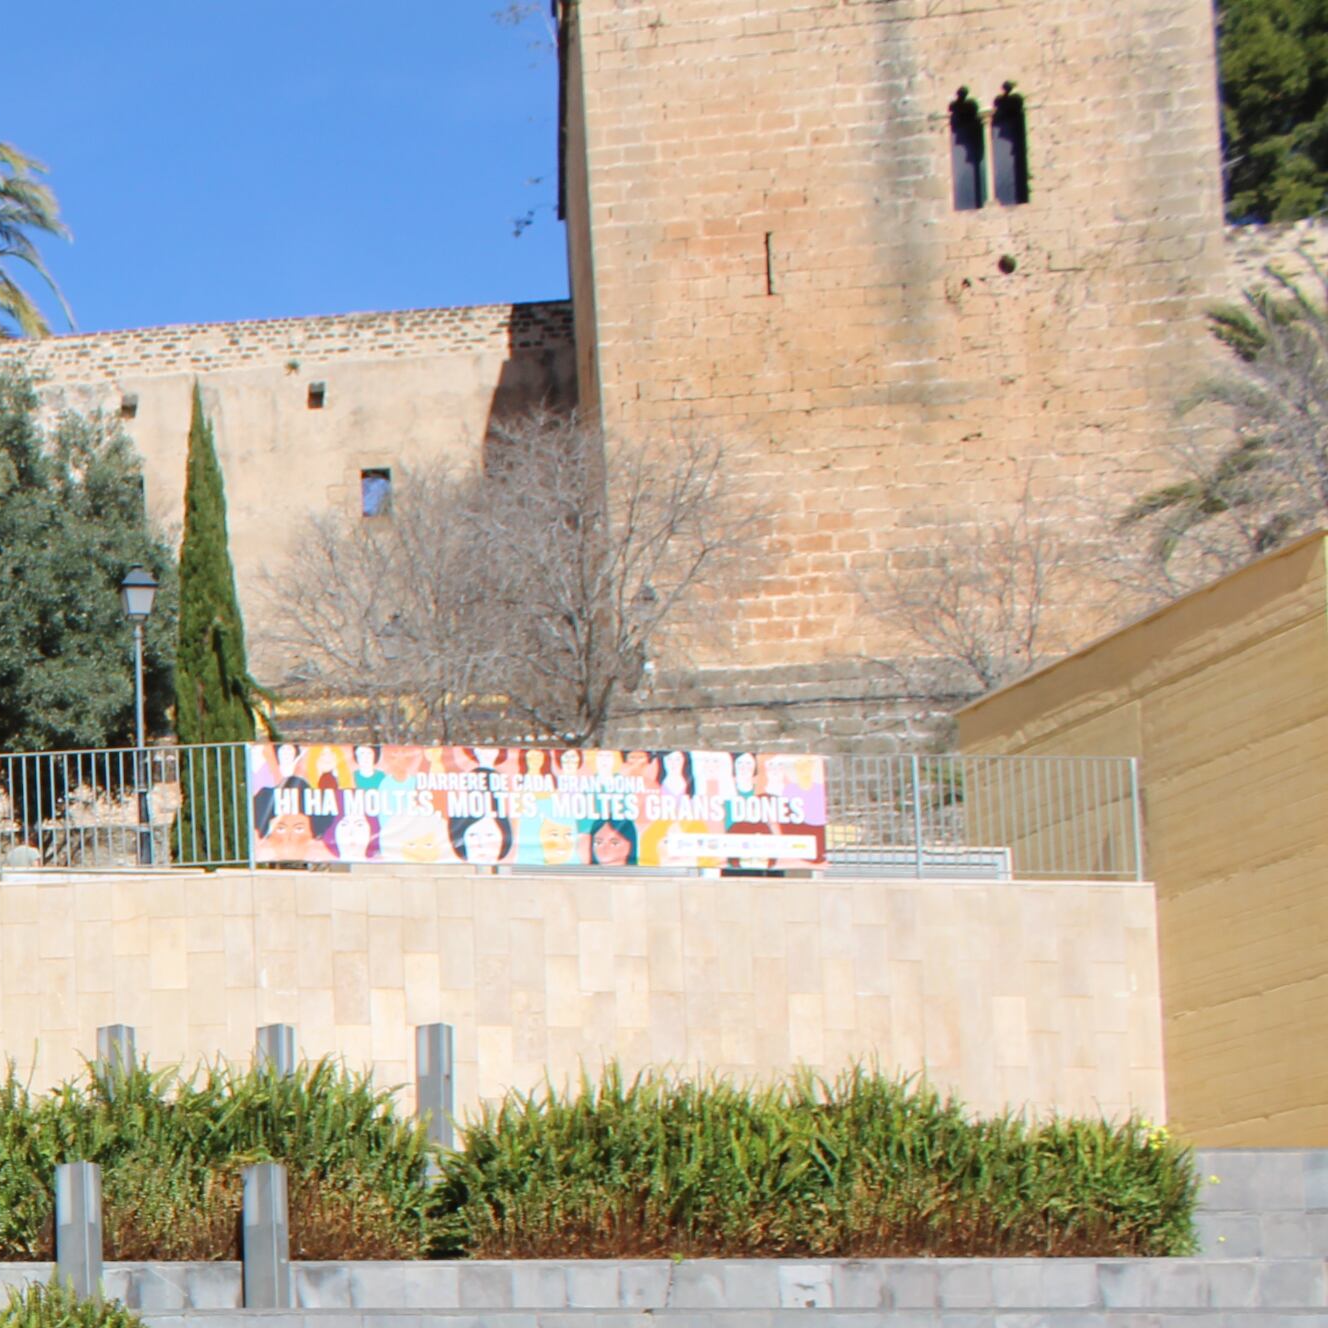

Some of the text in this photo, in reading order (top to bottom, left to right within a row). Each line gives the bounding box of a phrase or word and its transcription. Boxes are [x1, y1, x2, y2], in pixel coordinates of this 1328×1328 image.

[416, 772, 487, 791] DARRERE
[491, 773, 508, 791] DE
[511, 774, 553, 792] CADA
[557, 775, 602, 793] GRAN
[274, 787, 805, 824] HI HA MOLTES, MOLTES, MOLTES GRANS DONES
